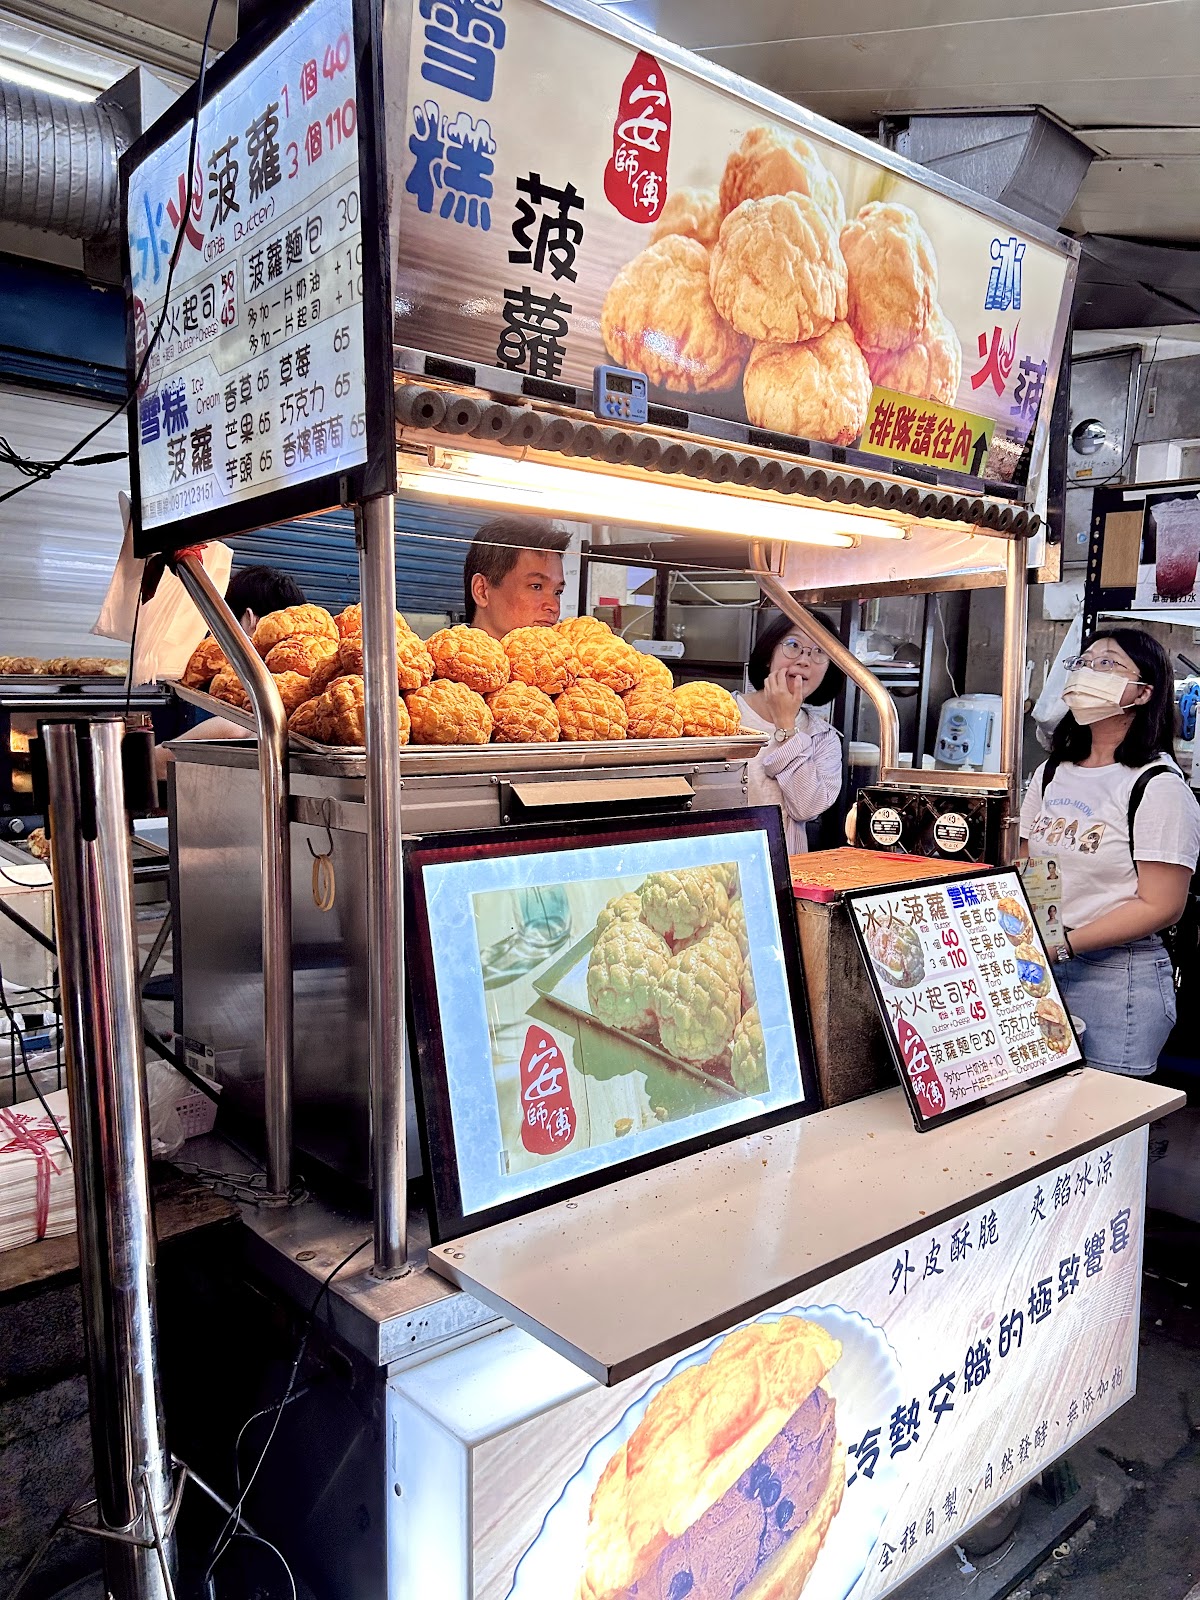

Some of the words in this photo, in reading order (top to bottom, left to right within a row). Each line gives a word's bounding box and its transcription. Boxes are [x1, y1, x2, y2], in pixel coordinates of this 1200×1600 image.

[248, 215, 323, 294] 菠蘿麵包
[336, 190, 360, 232] 30
[496, 171, 585, 381] 菠蘿
[220, 297, 236, 328] 45
[247, 269, 321, 330] 多加一片奶油
[248, 298, 321, 356] 多加一片起司
[191, 377, 204, 395] Ice
[224, 373, 253, 413] 香草
[257, 368, 270, 393] 65
[279, 343, 311, 388] 草莓
[333, 326, 351, 353] 65
[196, 392, 221, 415] Cream
[225, 412, 254, 450] 芒果
[258, 411, 271, 435] 65
[280, 380, 325, 426] 巧克力
[334, 372, 351, 398] 65
[225, 452, 253, 489] 芋頭
[259, 450, 272, 472] 65
[282, 414, 344, 468] 香檳葡萄
[350, 412, 366, 438] 65
[868, 398, 973, 466] 排隊請往內
[166, 423, 213, 485] 菠蘿
[854, 892, 950, 935] 冰火菠蘿
[960, 908, 984, 928] 香草
[984, 907, 997, 923] 65
[941, 928, 960, 949] 40
[947, 948, 968, 969] 110
[969, 933, 994, 954] 芒果
[993, 932, 1006, 948] 65
[978, 960, 1003, 983] 芋頭
[1002, 959, 1016, 975] 65
[885, 981, 963, 1022] 冰火起司
[969, 1000, 987, 1021] 45
[988, 987, 1013, 1008] 草莓
[1012, 985, 1025, 1001] 65
[888, 1208, 1000, 1296] 外皮酥脆
[1029, 1149, 1114, 1226] 夾餡冰涼
[846, 1207, 1133, 1488] 冷熱交織的極致饗宴
